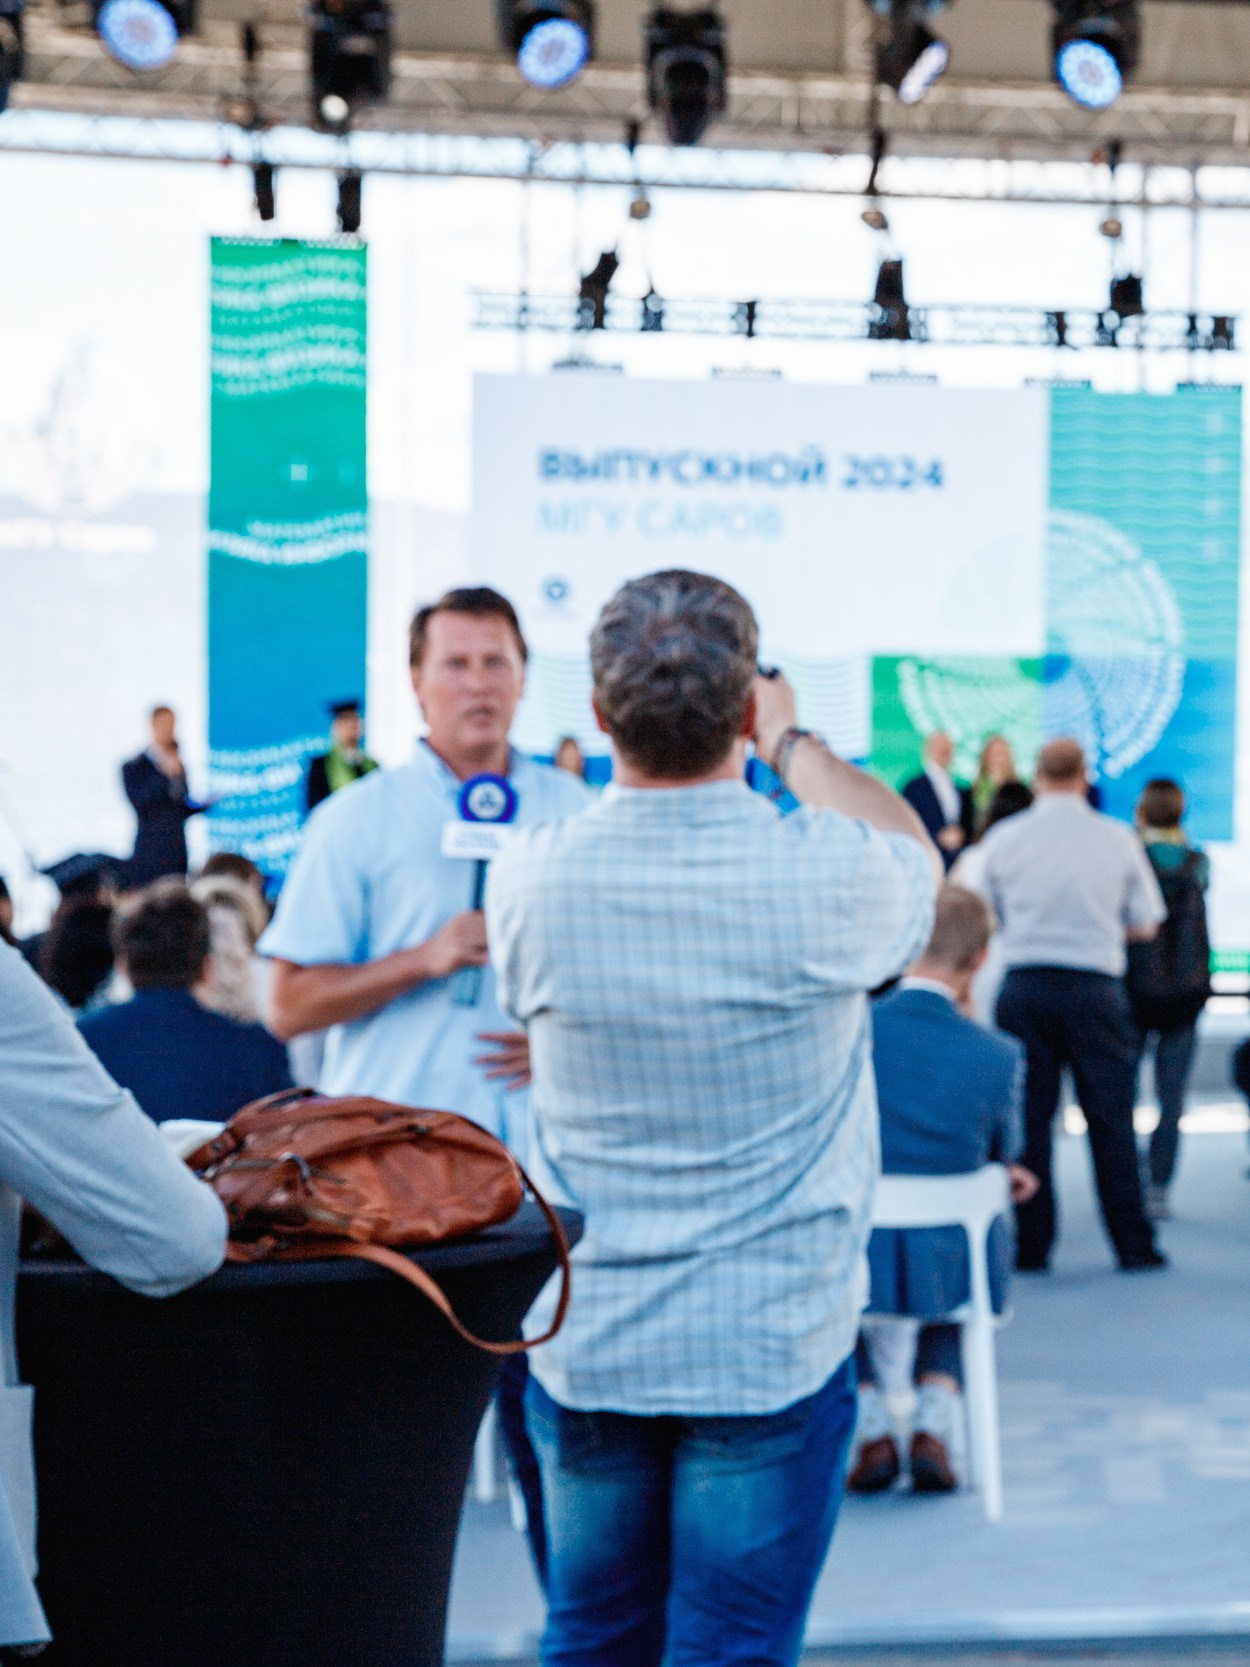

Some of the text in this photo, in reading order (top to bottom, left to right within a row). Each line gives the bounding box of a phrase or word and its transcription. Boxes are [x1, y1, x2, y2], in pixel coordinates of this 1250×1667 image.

[539, 445, 943, 490] ВЫПУСКНОЙ 2024
[540, 501, 784, 540] МГУ САРОВ
